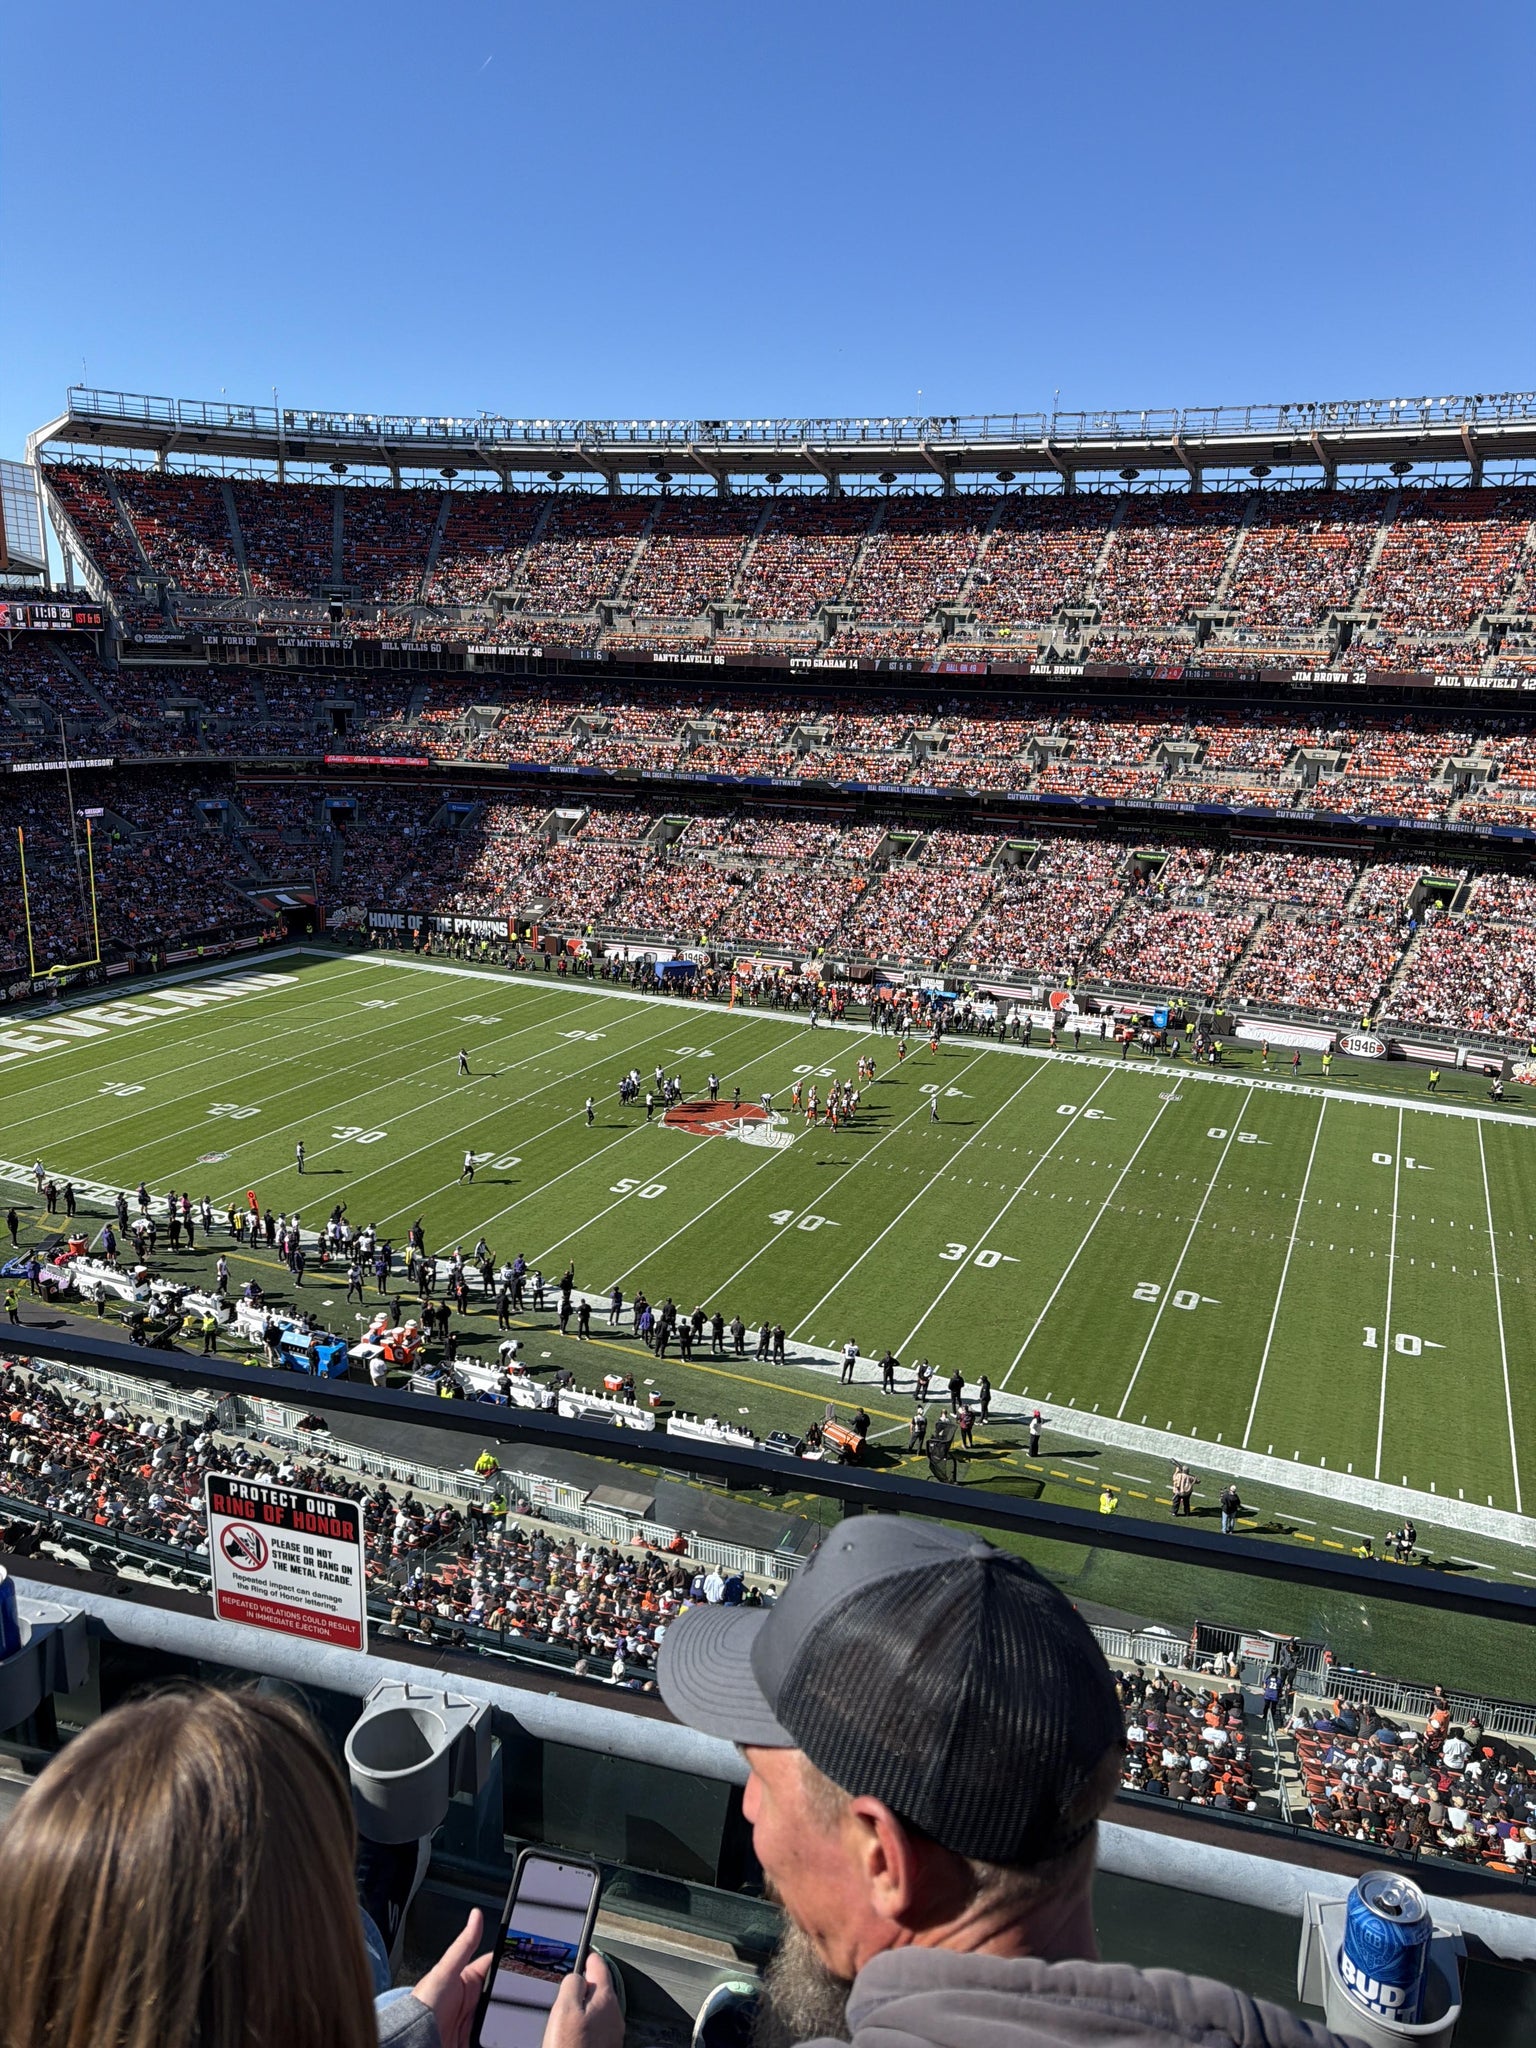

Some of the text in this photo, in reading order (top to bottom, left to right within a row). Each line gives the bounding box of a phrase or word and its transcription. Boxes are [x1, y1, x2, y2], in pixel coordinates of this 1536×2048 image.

[16, 608, 23, 620] 0
[35, 607, 57, 618] 11:16
[61, 608, 70, 618] 25
[202, 636, 257, 646] LEN FORD 80
[277, 638, 353, 650] CLAY MATTHEWS 57
[381, 642, 442, 653] BILL WILLIS 60
[467, 645, 542, 657] MARION MOTLEY 36
[653, 653, 725, 665] DANTE LAVELLI 86
[790, 658, 858, 670] OTTO GRAHAM 14
[1029, 664, 1084, 675] PAUL BROWN
[1292, 672, 1366, 684] JIM BROWN 32
[1434, 676, 1536, 690] PAUL WARFIELD 42
[12, 759, 114, 772] AMERICA BUILDS WITH GREGORY
[771, 778, 801, 786] CUTWATER
[1007, 793, 1040, 801] CUTWATER
[1154, 802, 1179, 810] PERFECTLY
[1275, 810, 1315, 820] CUTWATER
[1399, 820, 1493, 834] REAL COCKTAILS. PERFECTLY MIXED.
[369, 912, 405, 929] HOME
[407, 915, 424, 929] OF
[460, 1014, 502, 1025] 20
[564, 1030, 606, 1041] 30
[674, 1047, 715, 1058] 40
[1349, 1039, 1376, 1054] 1946
[792, 1064, 836, 1078] 50
[1054, 1053, 1326, 1096] INTERCEPT CANCER
[98, 1082, 146, 1096] 10
[918, 1083, 964, 1098] 40
[206, 1103, 261, 1119] 20
[1056, 1104, 1105, 1120] 30
[331, 1126, 388, 1144] 30
[1206, 1128, 1257, 1144] 20
[1372, 1152, 1416, 1169] 10
[609, 1179, 667, 1198] 50
[768, 1209, 825, 1231] 40
[938, 1242, 1002, 1268] 30
[1132, 1282, 1201, 1310] 20
[1362, 1326, 1421, 1356] 10
[229, 1482, 337, 1518] PROTECT OUR
[214, 1493, 354, 1540] RING OF HONOR
[271, 1538, 332, 1560] PLEASE DO NOT
[272, 1550, 353, 1575] STRIKE OR BANG ON
[273, 1561, 352, 1586] THE METAL FACADE.
[232, 1572, 342, 1604] Repeated impact can damage
[237, 1582, 338, 1611] the Ring of Honor lettering.
[222, 1596, 356, 1633] REPEATED VIOLATIONS COULD RESULT
[246, 1610, 332, 1636] IN IMMEDIATE EJECTION.
[1342, 1951, 1406, 2007] BUD
